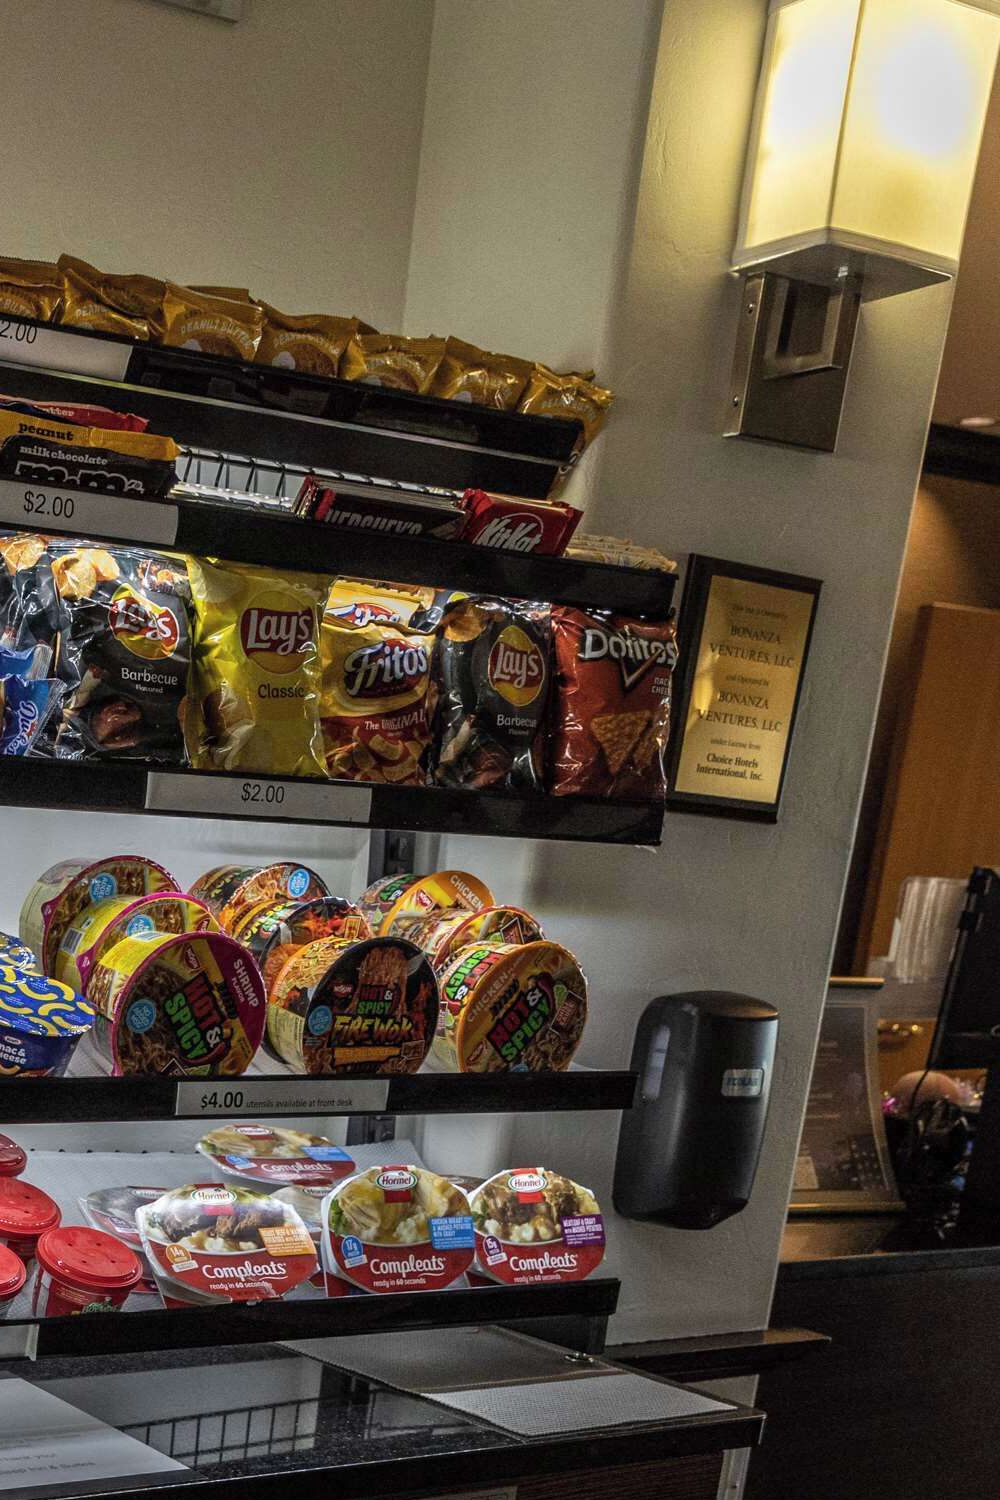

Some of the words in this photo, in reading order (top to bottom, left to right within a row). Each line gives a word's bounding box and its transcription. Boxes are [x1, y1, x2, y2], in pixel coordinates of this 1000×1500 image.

[17, 421, 74, 442] peanut
[19, 444, 50, 458] milk
[50, 450, 109, 466] chocolate
[23, 490, 75, 519] $2.00
[246, 608, 311, 656] Lay's
[730, 624, 781, 645] BONANZA
[578, 626, 678, 666] Doritos
[343, 645, 428, 697] Fritos
[493, 642, 539, 689] Lay's
[774, 655, 795, 669] LLC
[121, 666, 178, 686] Barbecue
[258, 684, 305, 699] Classic
[718, 690, 769, 710] BONANZA
[364, 720, 379, 730] The
[496, 713, 537, 728] Barbecue
[762, 719, 783, 732] LLC
[706, 752, 734, 766] Choice
[734, 755, 759, 769] Hotels
[241, 782, 285, 804] $2.00
[450, 874, 486, 911] CHICKEN
[232, 958, 259, 1008] SHRIMP
[383, 989, 393, 1001] &
[466, 973, 509, 1023] CHICKEN
[357, 1001, 392, 1015] SPICY
[164, 991, 208, 1060] SPICY
[205, 1025, 222, 1047] &
[500, 996, 549, 1062] SPICY
[17, 1048, 25, 1056] &
[200, 1091, 244, 1109] $4.00
[316, 1098, 335, 1107] front
[380, 1174, 412, 1186] Hormel
[514, 1178, 541, 1187] Hormel
[197, 1190, 231, 1201] Hormel
[202, 1260, 288, 1282] Compleats
[369, 1254, 446, 1278] Compleats
[509, 1251, 578, 1274] Compleats
[209, 1283, 229, 1291] ready
[373, 1279, 390, 1288] ready
[396, 1278, 404, 1286] 60
[404, 1277, 427, 1285] seconds
